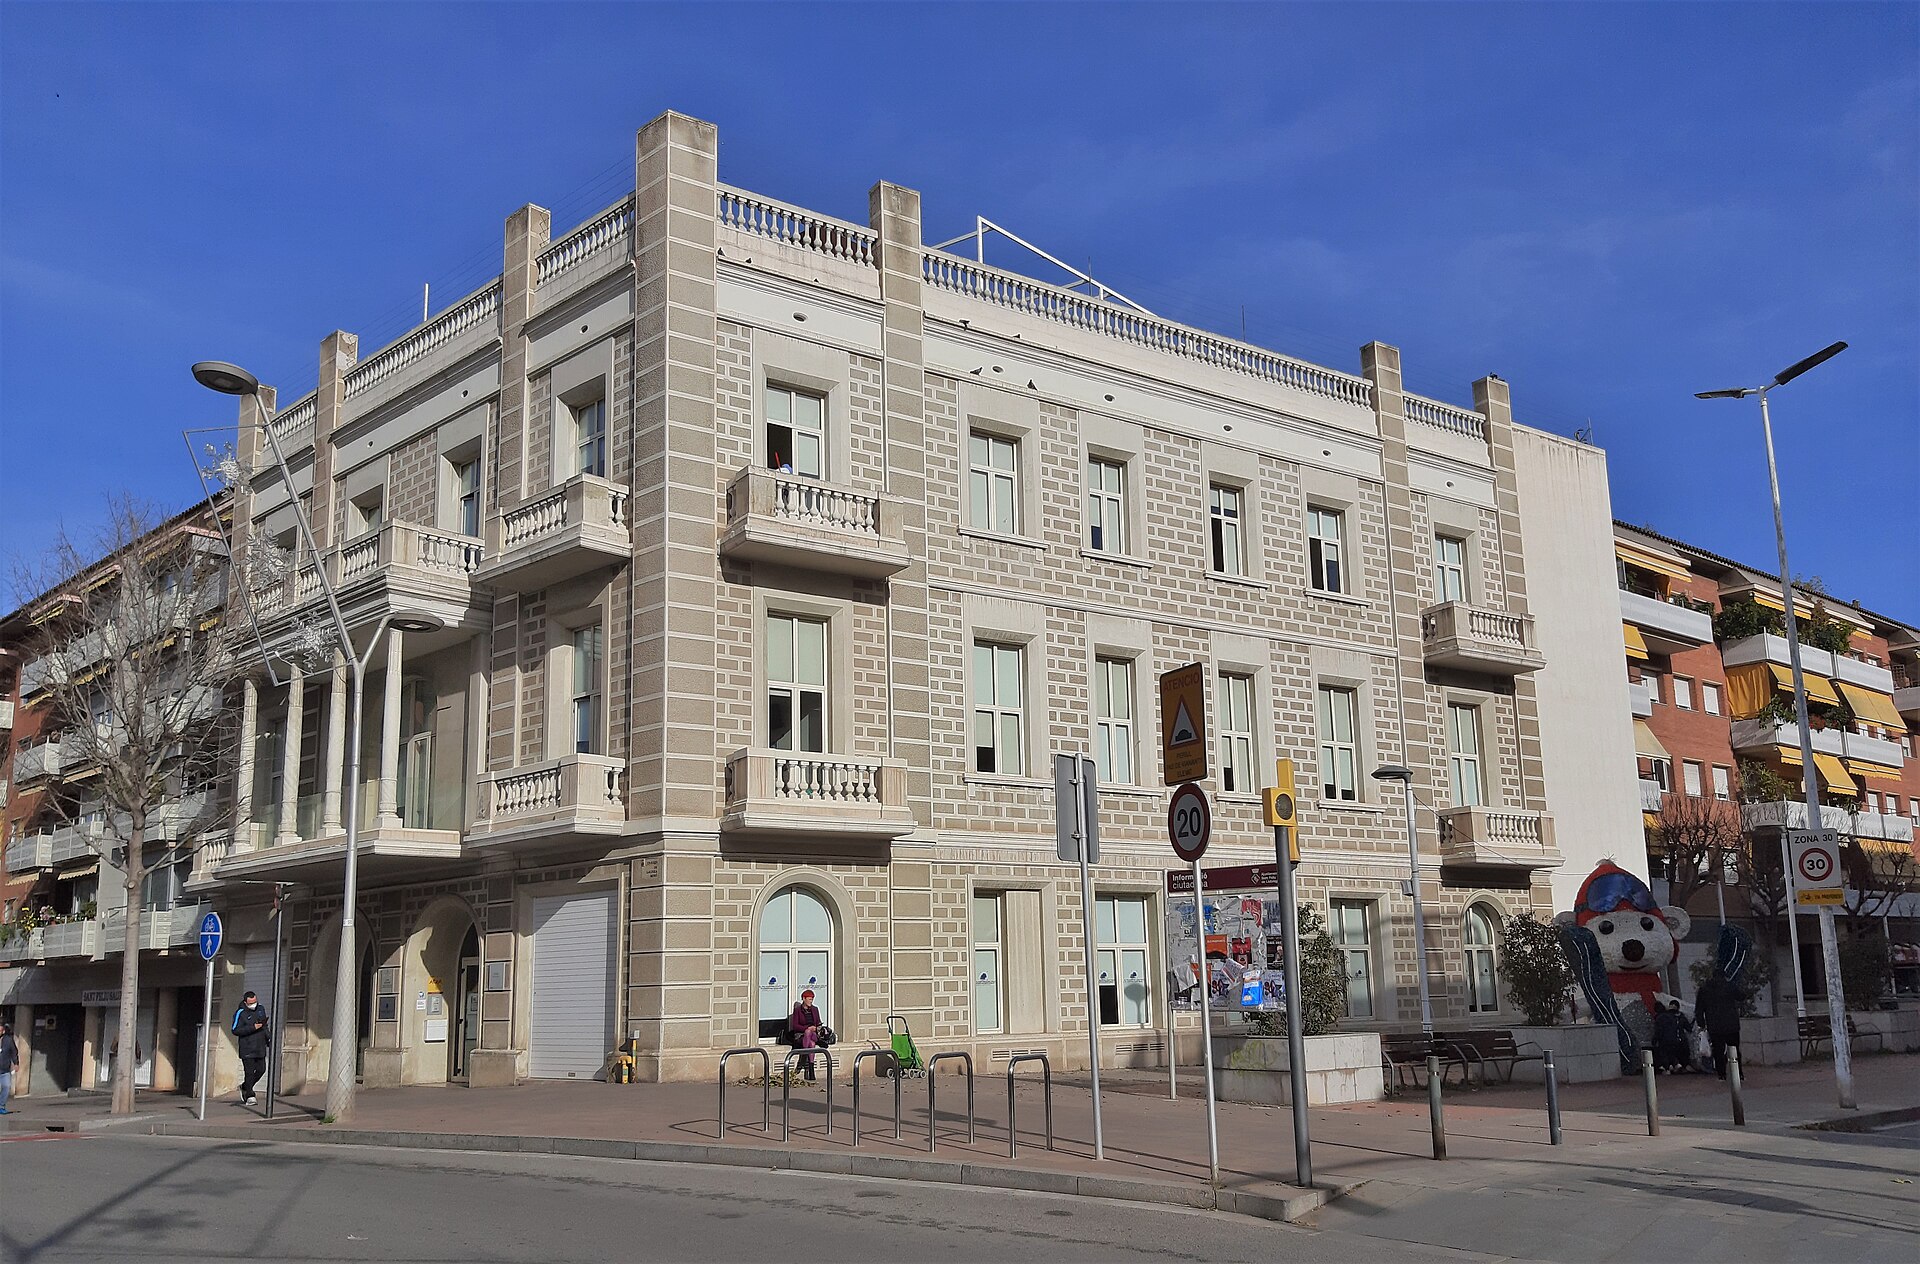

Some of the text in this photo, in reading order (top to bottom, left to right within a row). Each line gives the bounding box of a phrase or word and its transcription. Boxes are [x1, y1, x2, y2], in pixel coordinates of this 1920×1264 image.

[1177, 807, 1201, 838] 20
[1794, 834, 1833, 844] ZONA 30
[1806, 858, 1826, 870] 30
[1172, 872, 1208, 881] Informió
